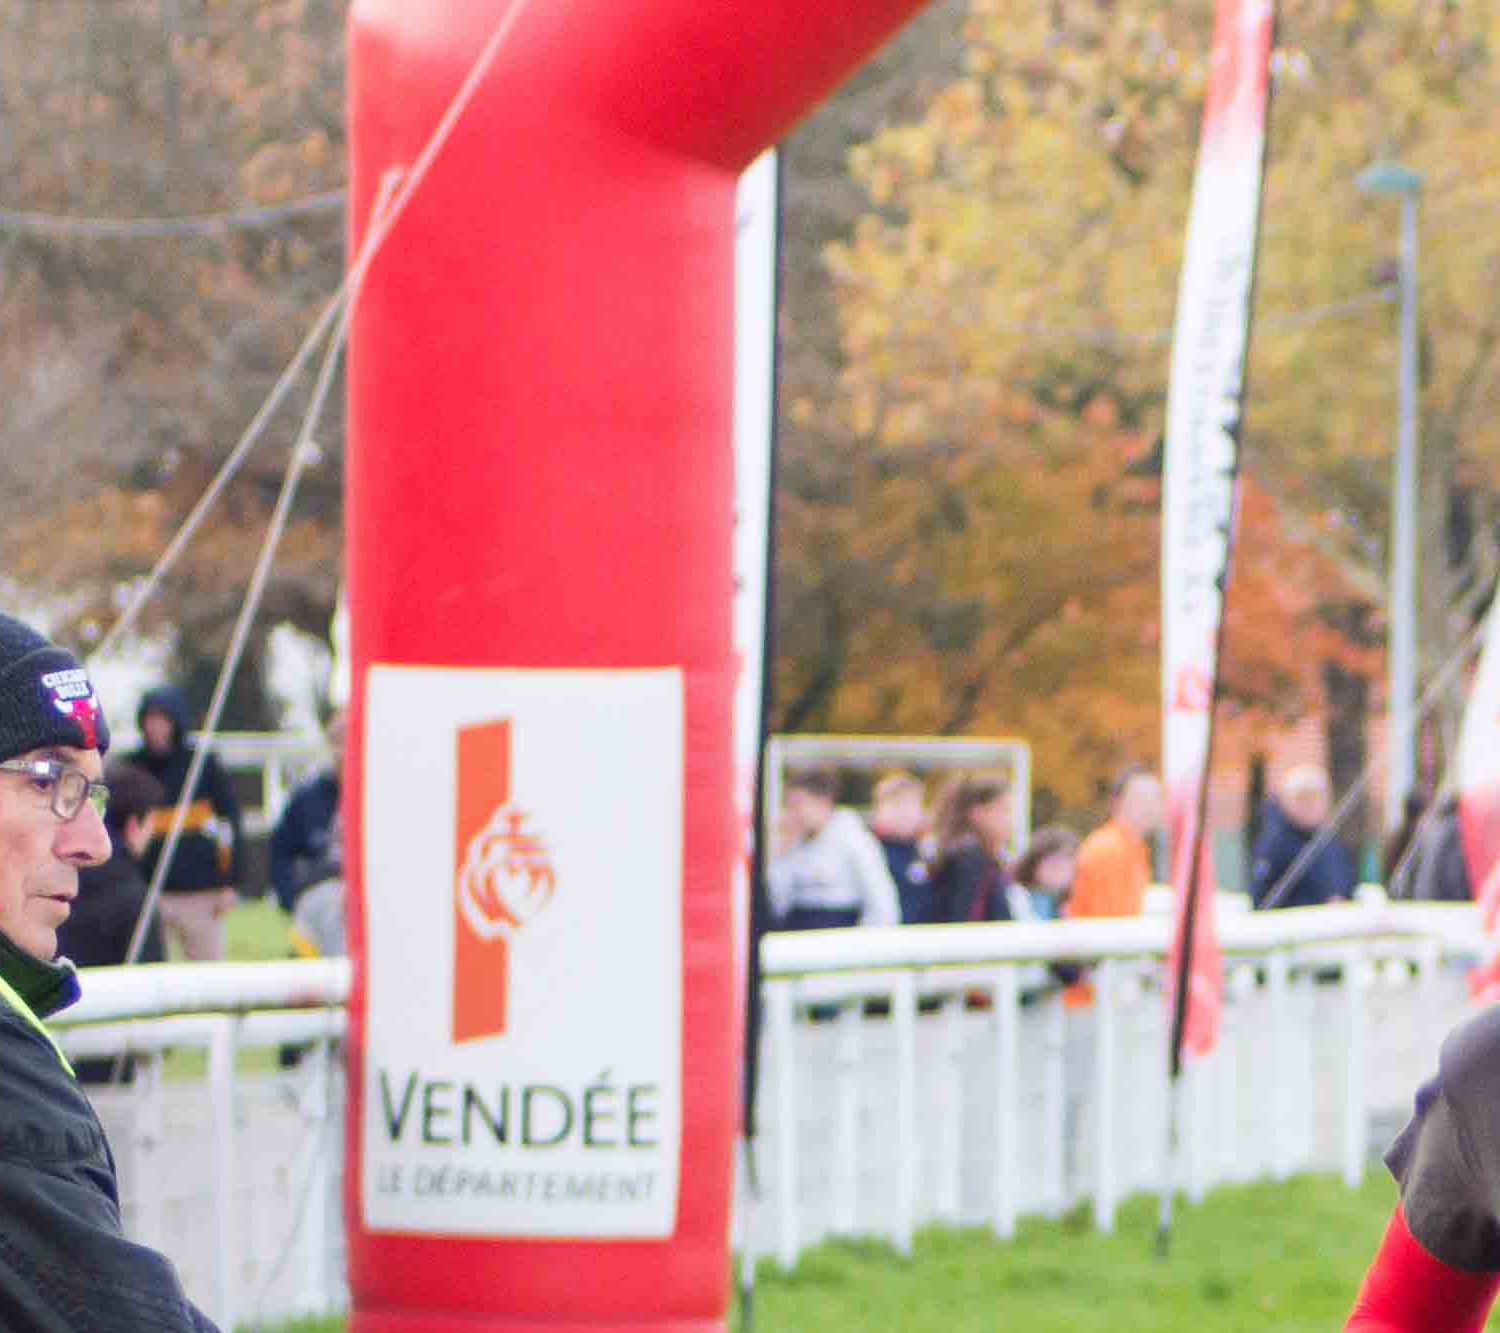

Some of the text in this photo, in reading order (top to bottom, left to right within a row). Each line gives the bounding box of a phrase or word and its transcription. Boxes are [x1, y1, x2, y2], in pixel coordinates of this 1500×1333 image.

[379, 1066, 659, 1148] VENDÉE
[380, 1163, 659, 1200] LE DÉPARTEMENT
